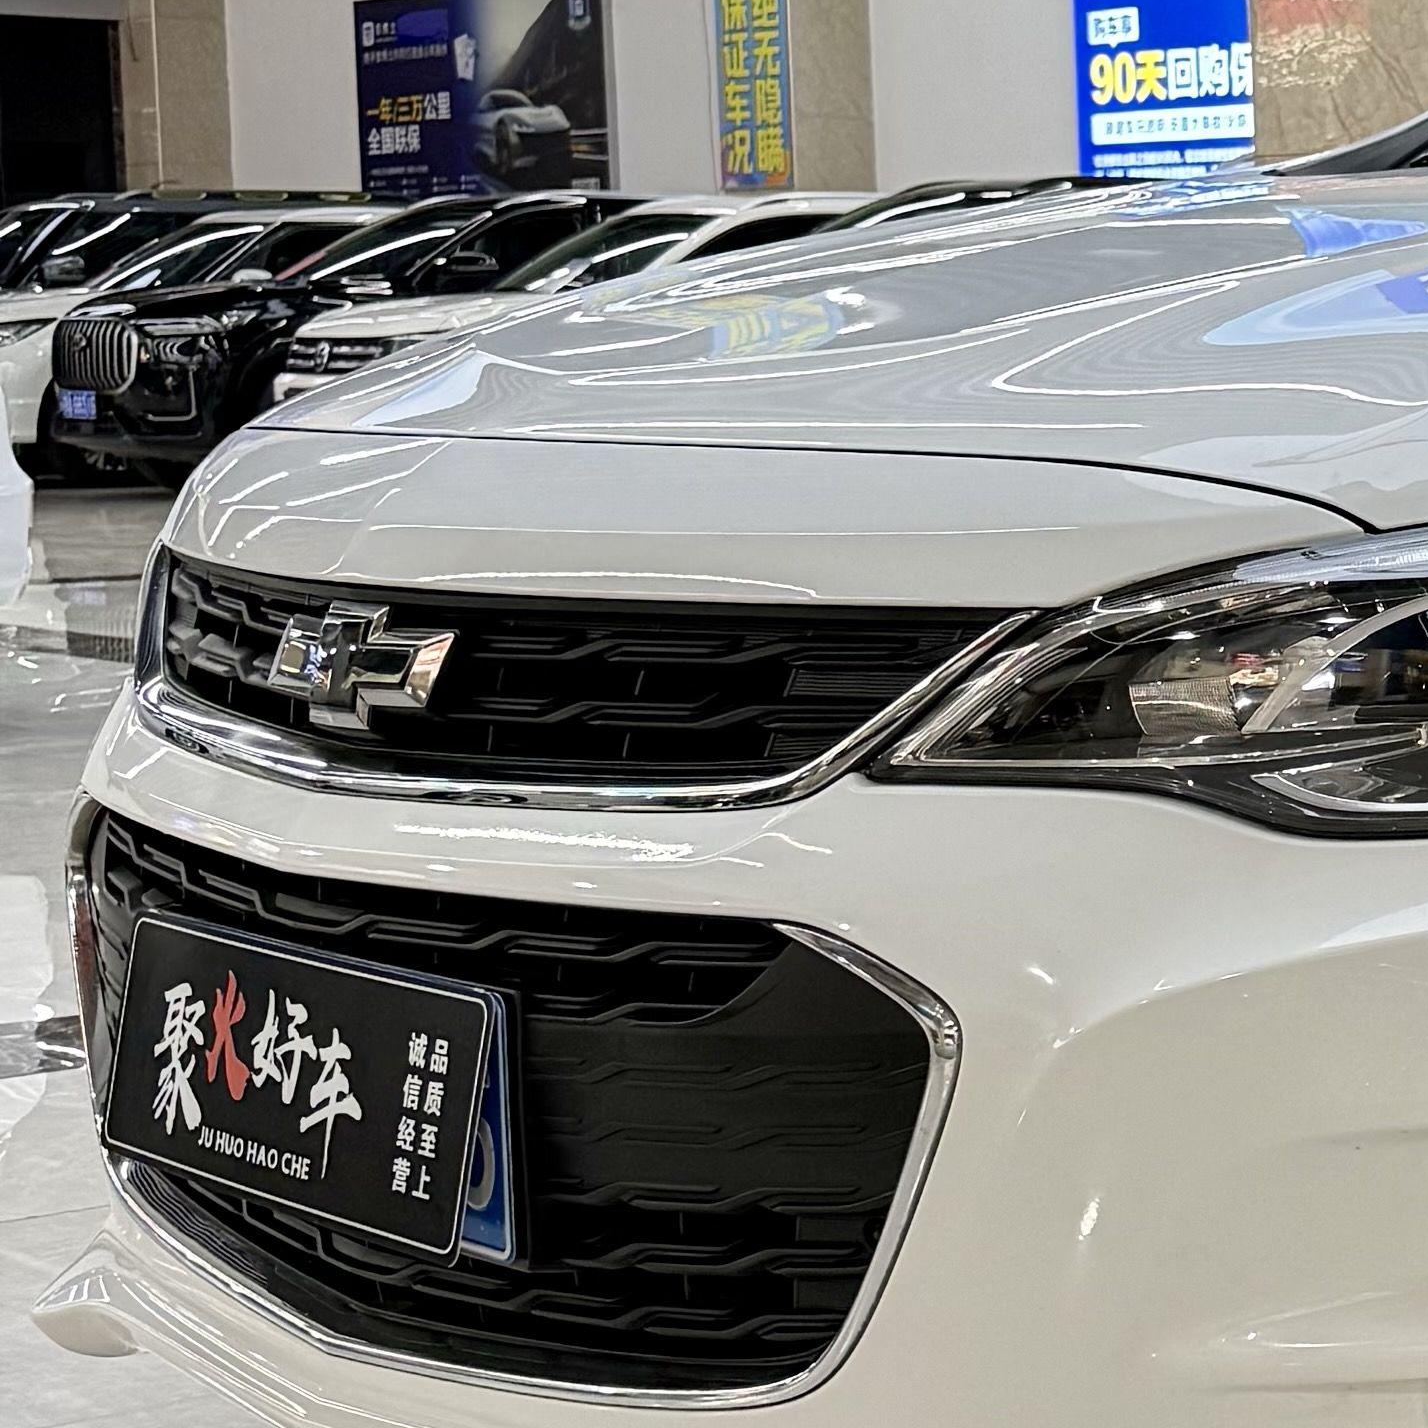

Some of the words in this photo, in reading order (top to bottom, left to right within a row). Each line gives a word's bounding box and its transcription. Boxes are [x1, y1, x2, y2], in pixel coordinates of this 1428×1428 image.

[152, 969, 362, 1179] 聚火好车
[198, 1125, 214, 1147] JU
[215, 1131, 244, 1158] HUO
[246, 1142, 278, 1169] HAO
[281, 1152, 310, 1181] CHE
[391, 1031, 428, 1195] 诚信经营
[411, 1038, 450, 1201] 品质至上
